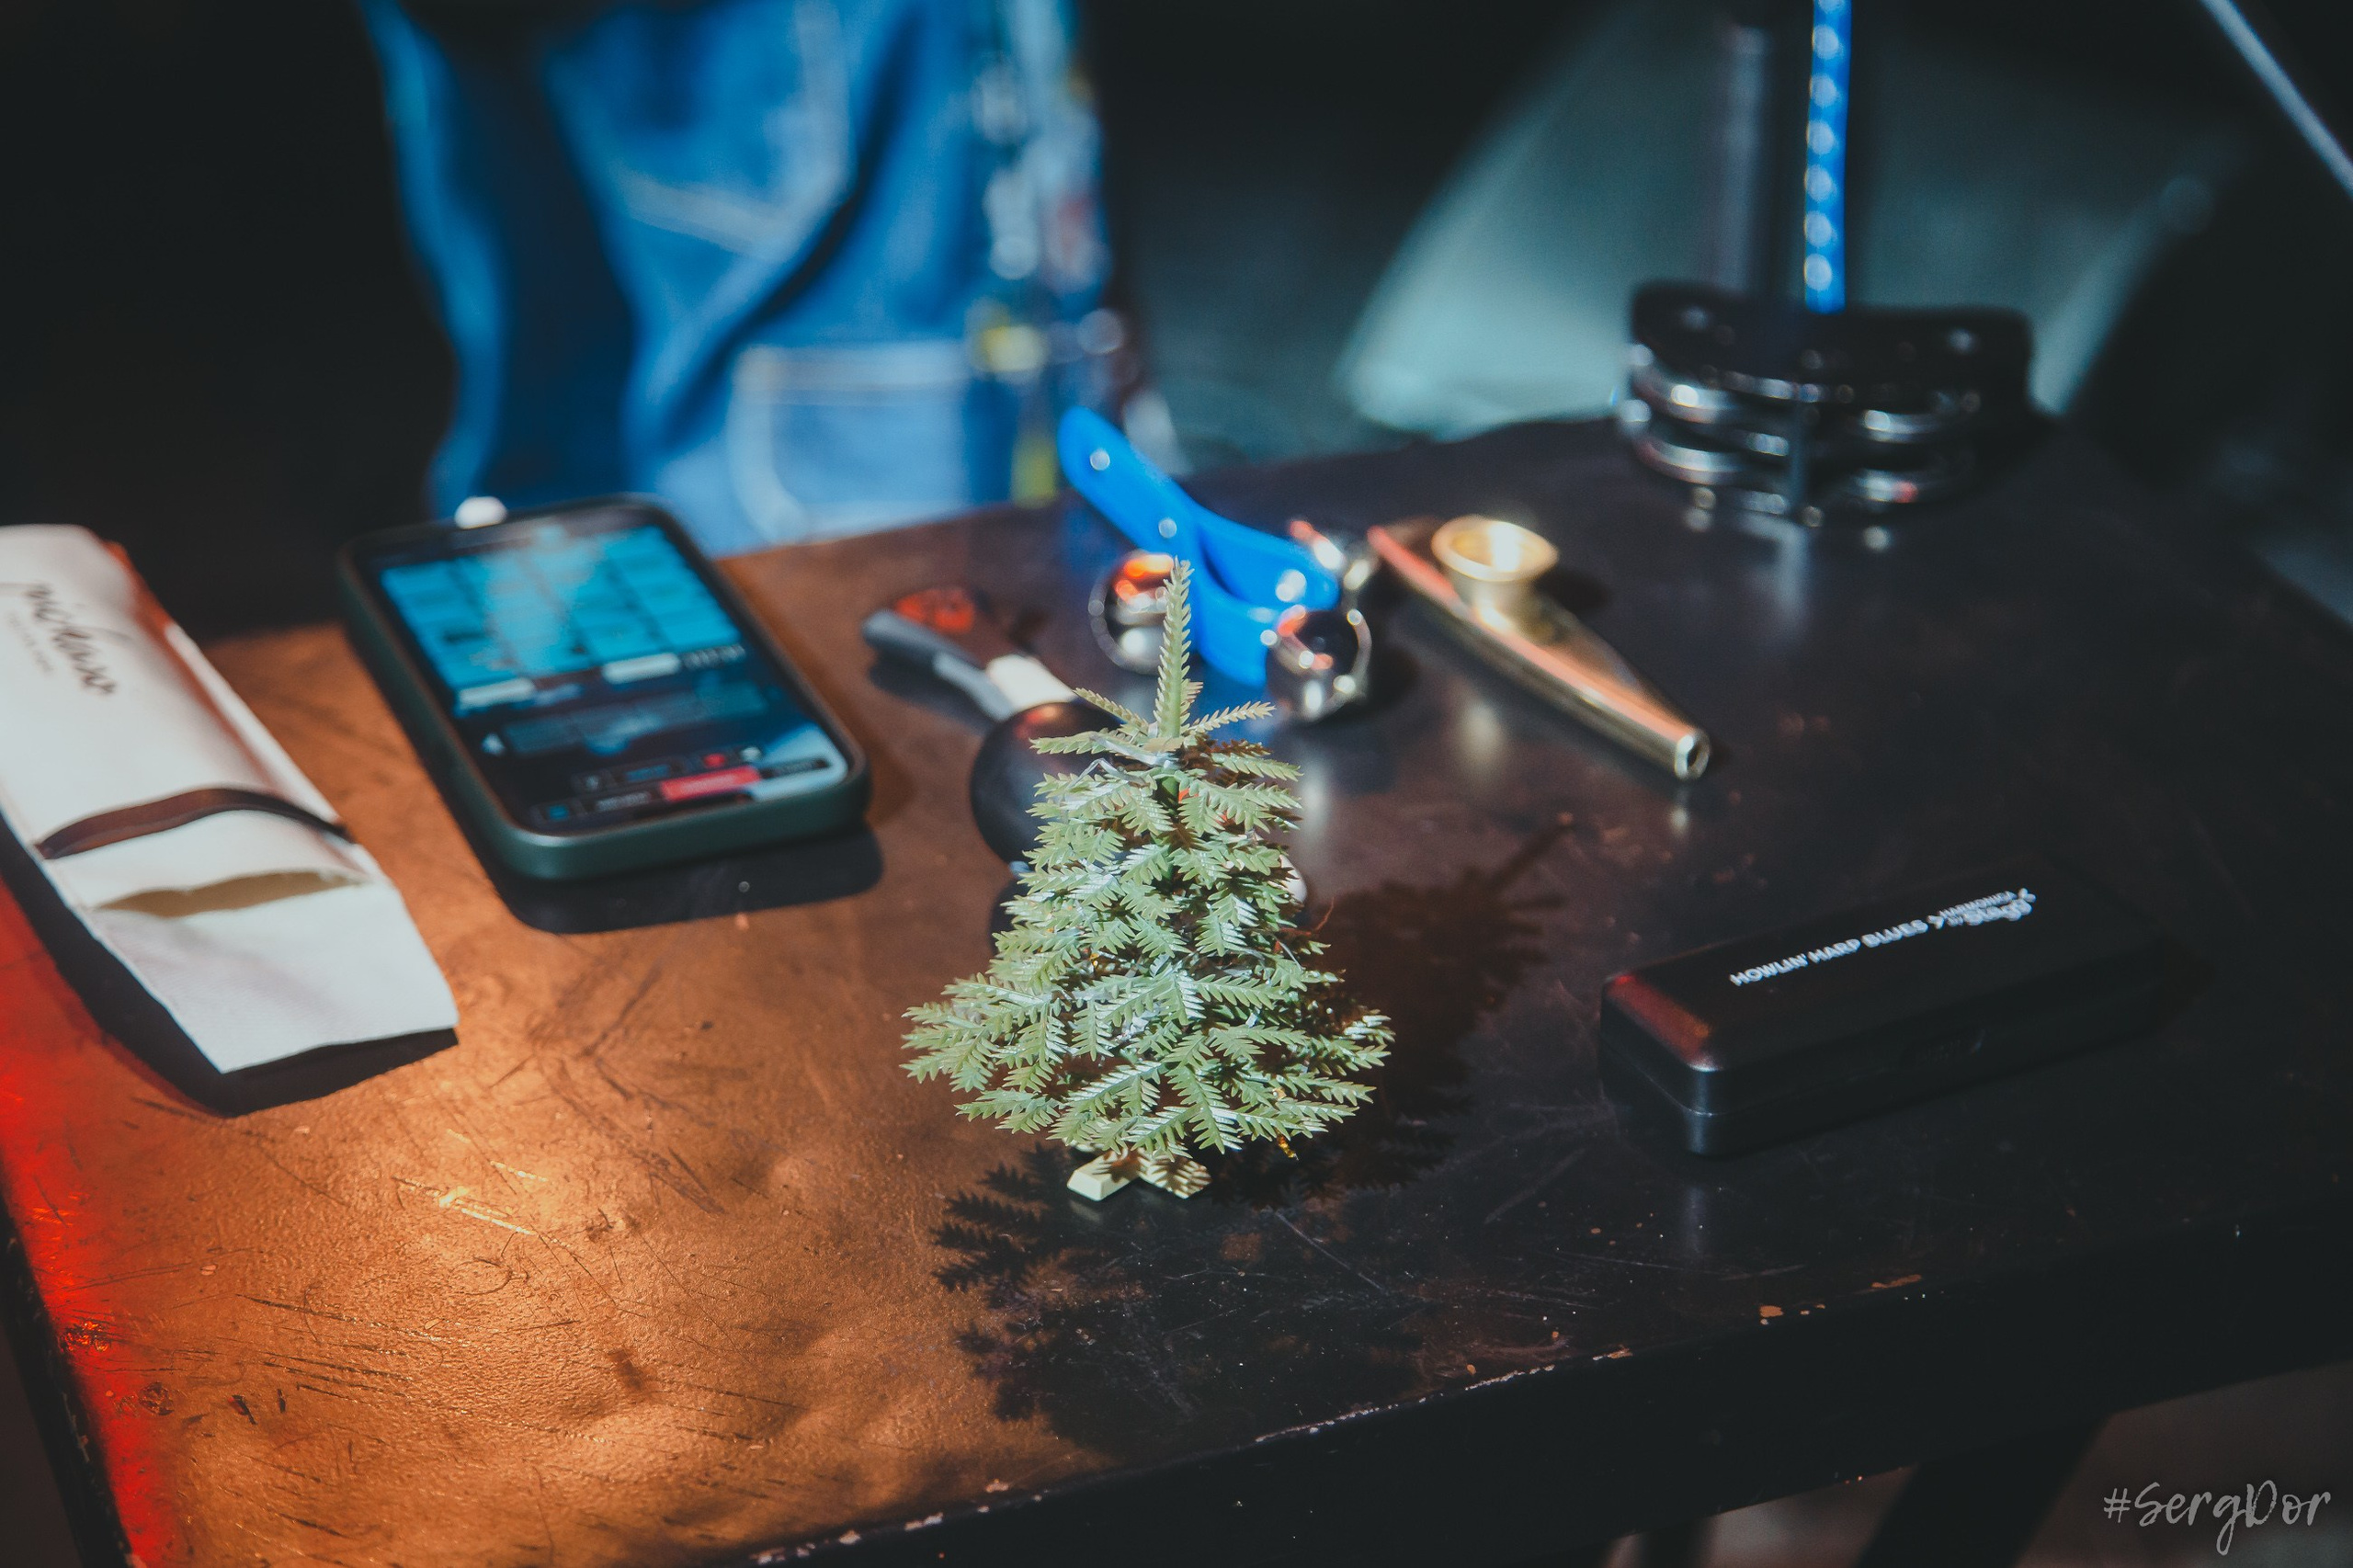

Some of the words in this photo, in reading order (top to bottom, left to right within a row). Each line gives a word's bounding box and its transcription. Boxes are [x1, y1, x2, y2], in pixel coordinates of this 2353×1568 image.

[1730, 953, 1808, 986] HOWLIN'
[1807, 938, 1860, 963] HARP
[1861, 919, 1928, 948] BLUES
